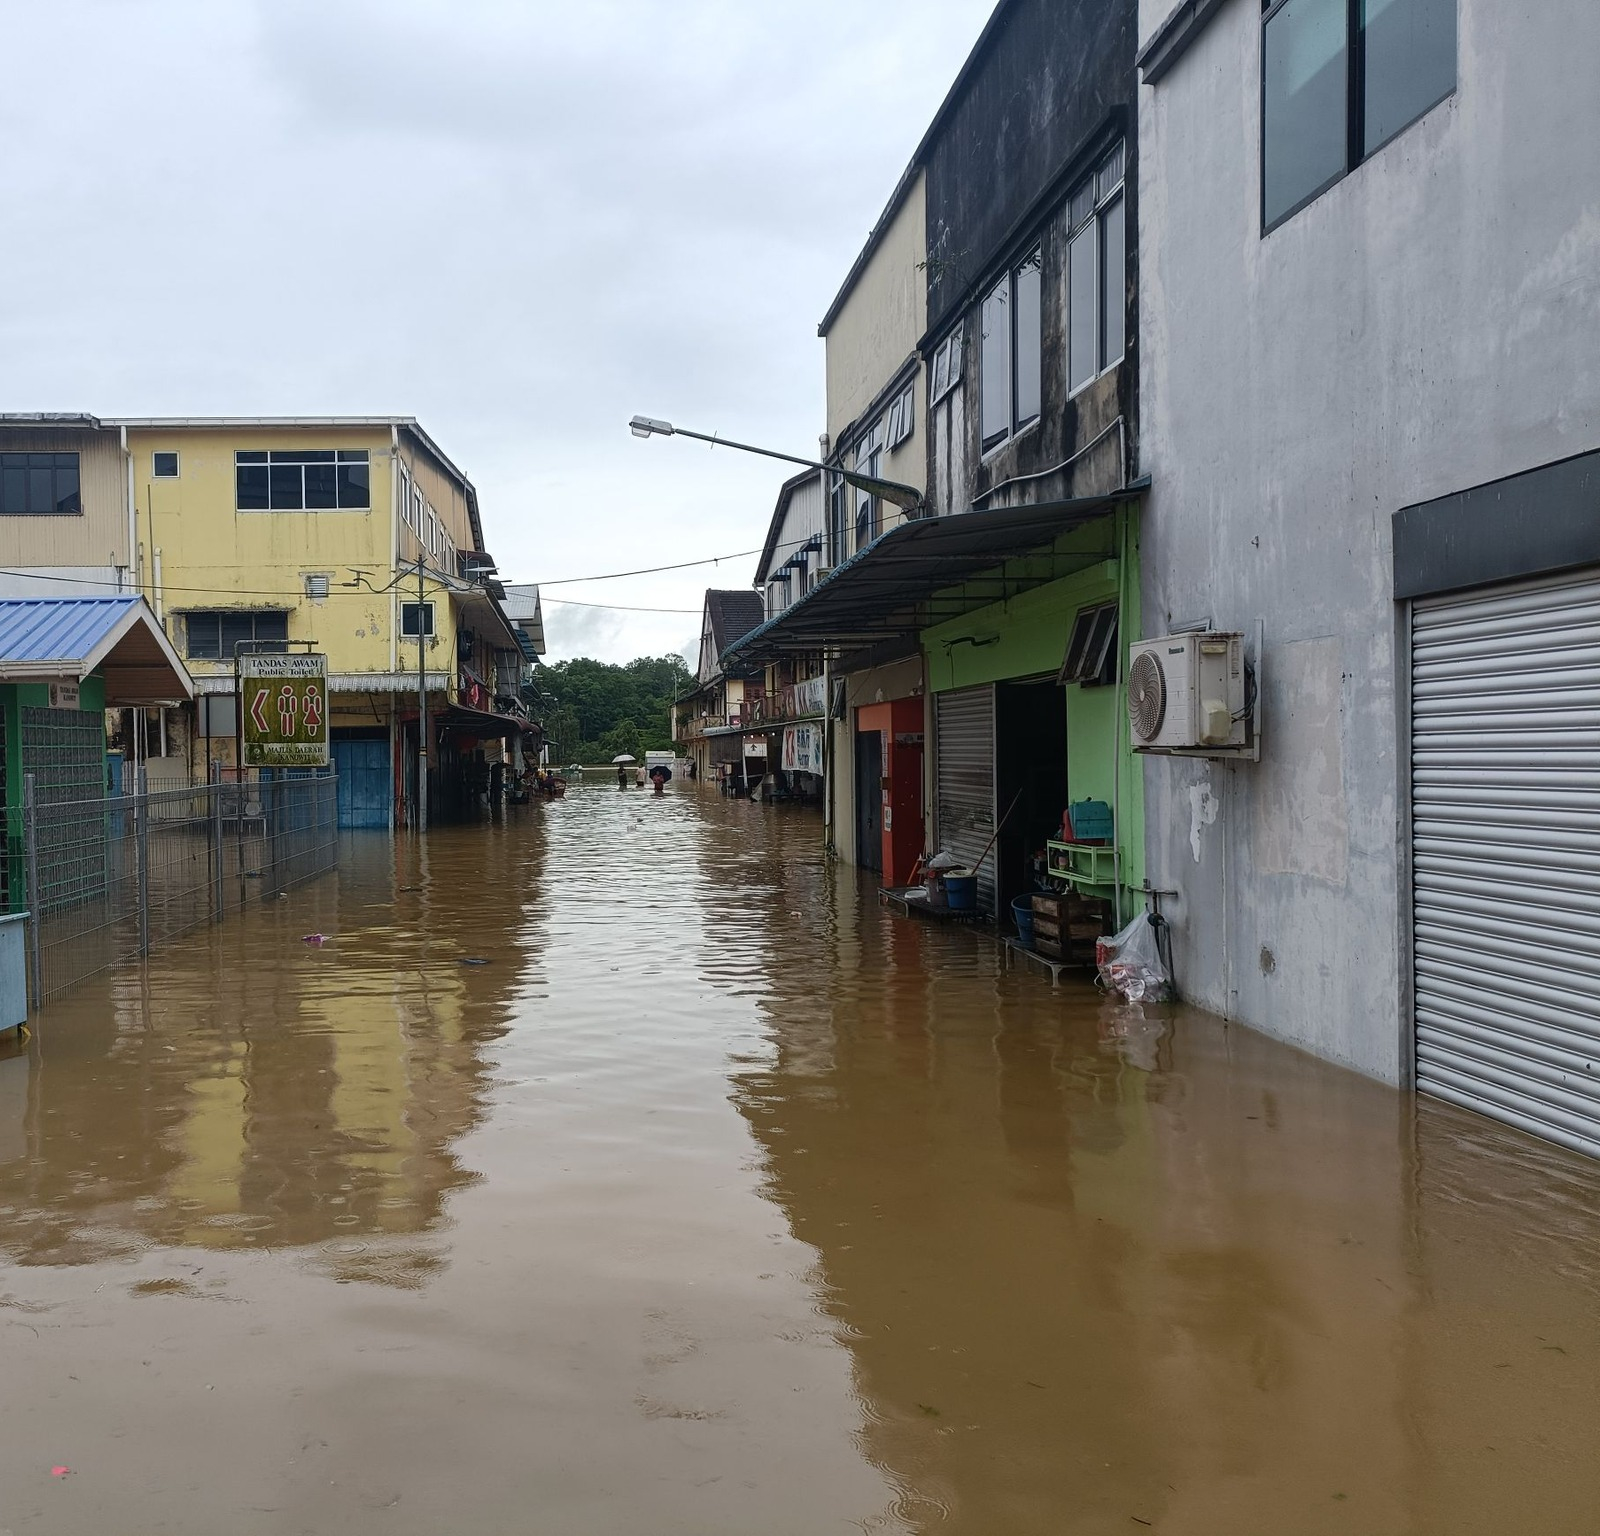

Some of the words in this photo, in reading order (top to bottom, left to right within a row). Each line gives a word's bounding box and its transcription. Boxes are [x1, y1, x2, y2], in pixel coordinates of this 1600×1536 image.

[251, 660, 287, 668] TANDAS
[292, 660, 318, 668] AWAM
[268, 746, 293, 754] MAJLIS
